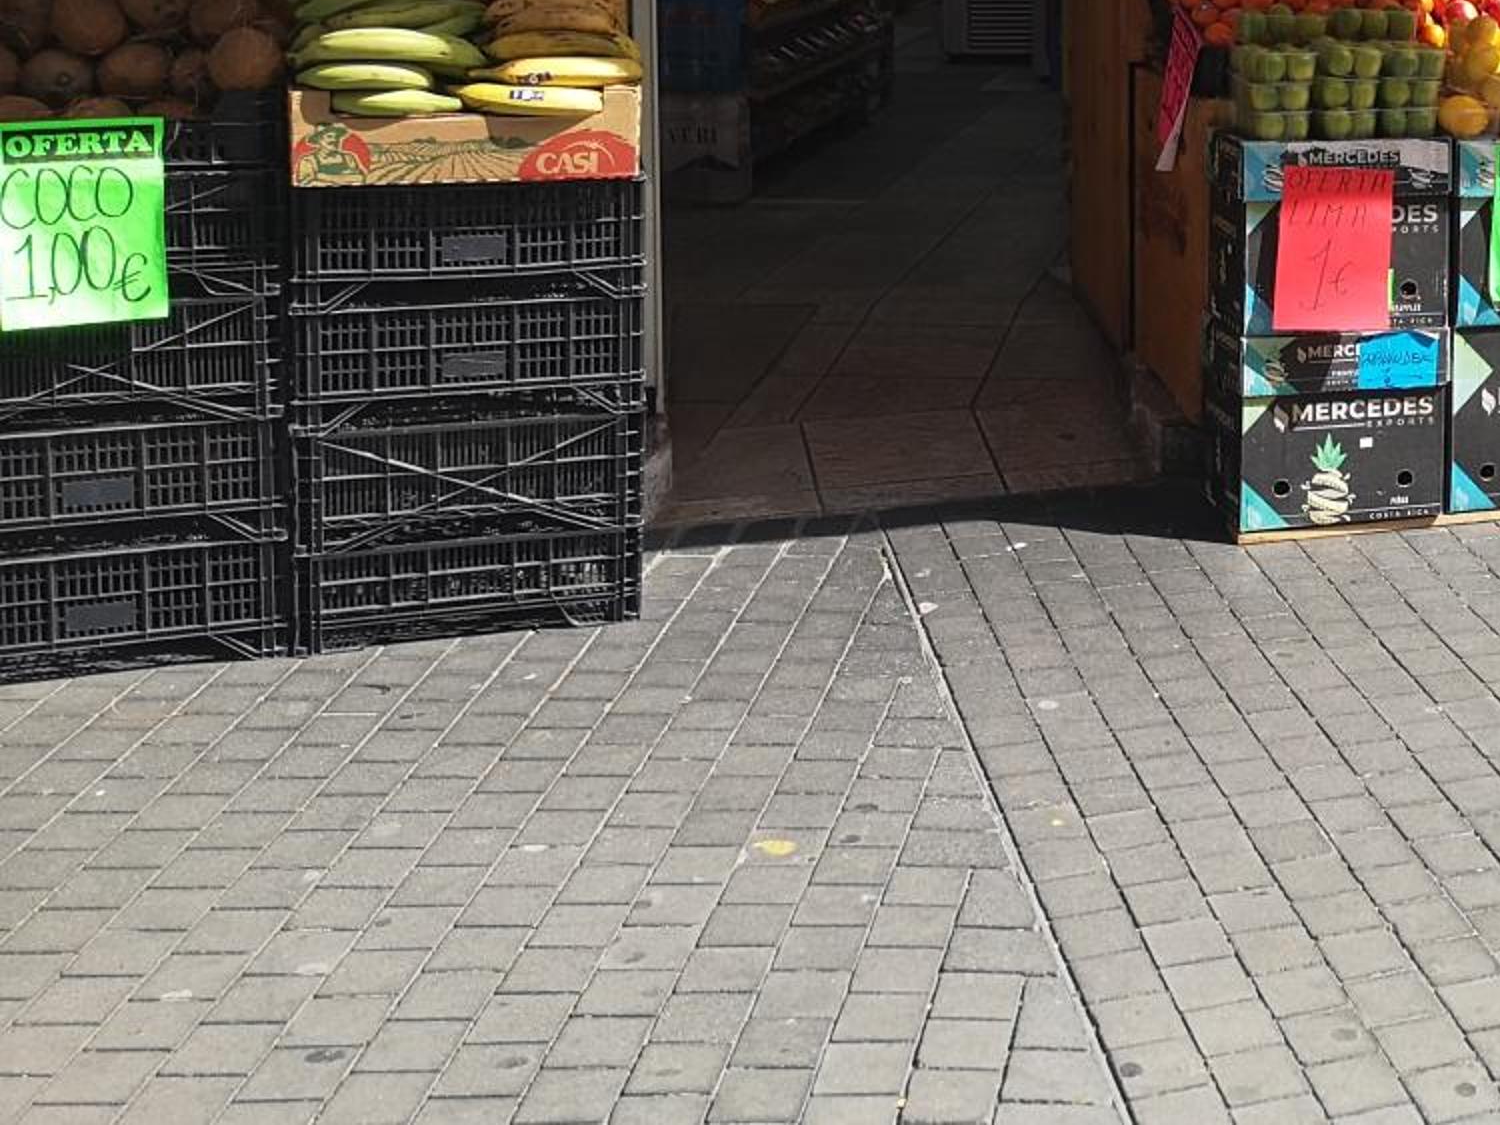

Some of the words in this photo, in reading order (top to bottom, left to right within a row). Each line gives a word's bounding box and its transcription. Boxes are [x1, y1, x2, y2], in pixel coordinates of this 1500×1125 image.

[5, 130, 153, 160] OFERTA
[536, 151, 602, 175] CASI
[1308, 150, 1400, 166] MERCEDES
[1284, 170, 1388, 194] OFERTA
[0, 165, 134, 230] COCO
[1291, 396, 1434, 422] MERCEDES
